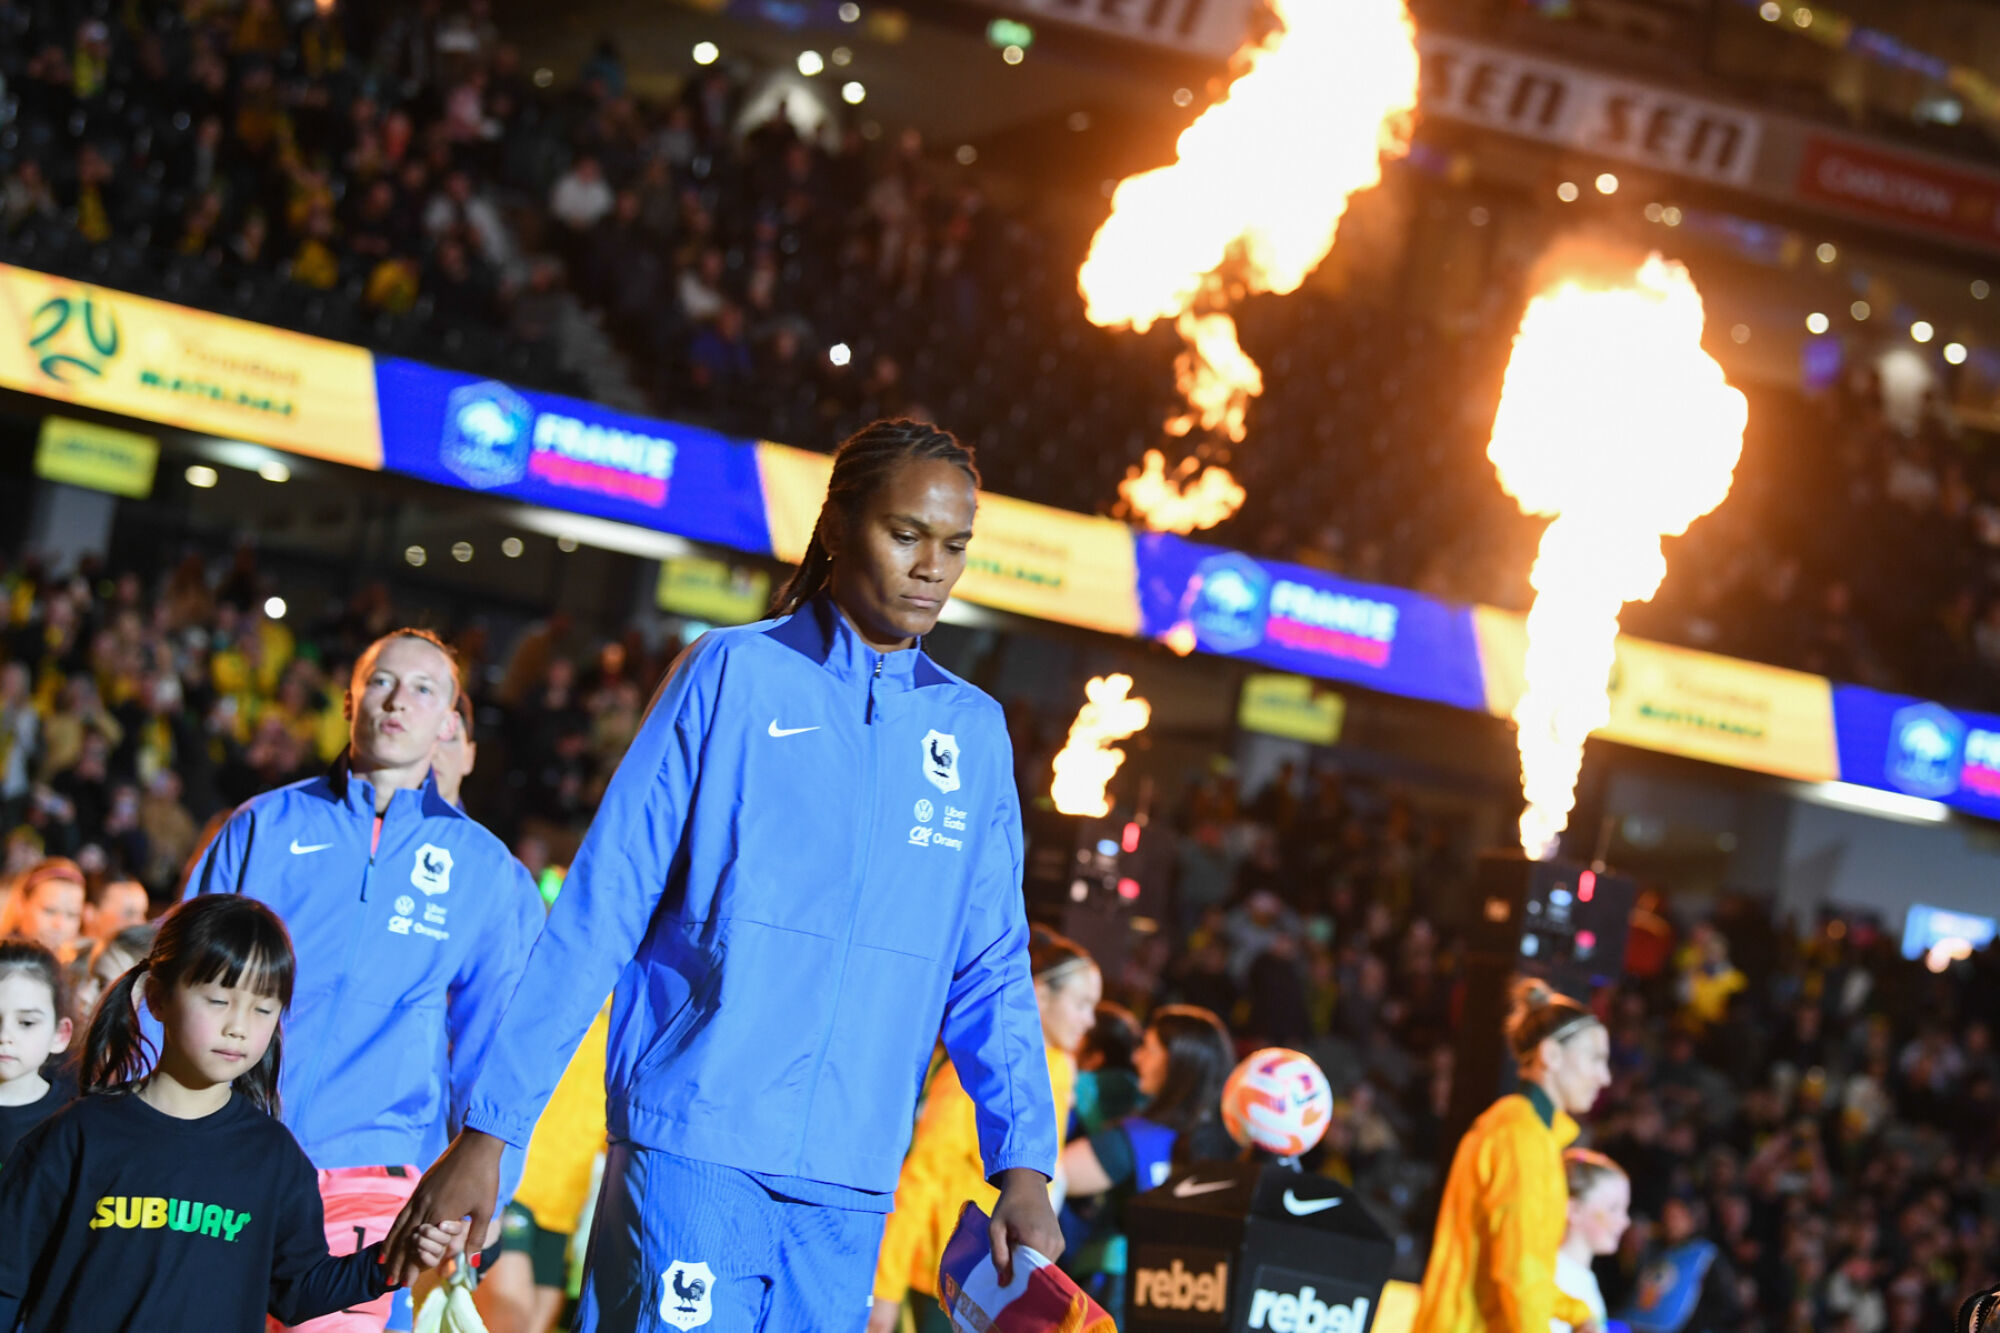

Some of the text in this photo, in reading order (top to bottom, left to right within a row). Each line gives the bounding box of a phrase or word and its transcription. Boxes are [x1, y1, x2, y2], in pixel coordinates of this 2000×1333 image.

[533, 411, 678, 480] FRANCE
[1269, 579, 1399, 643] FRANCE
[89, 1196, 252, 1242] SUBWAY
[1134, 1258, 1228, 1313] rebel
[1248, 1285, 1370, 1333] rebel
